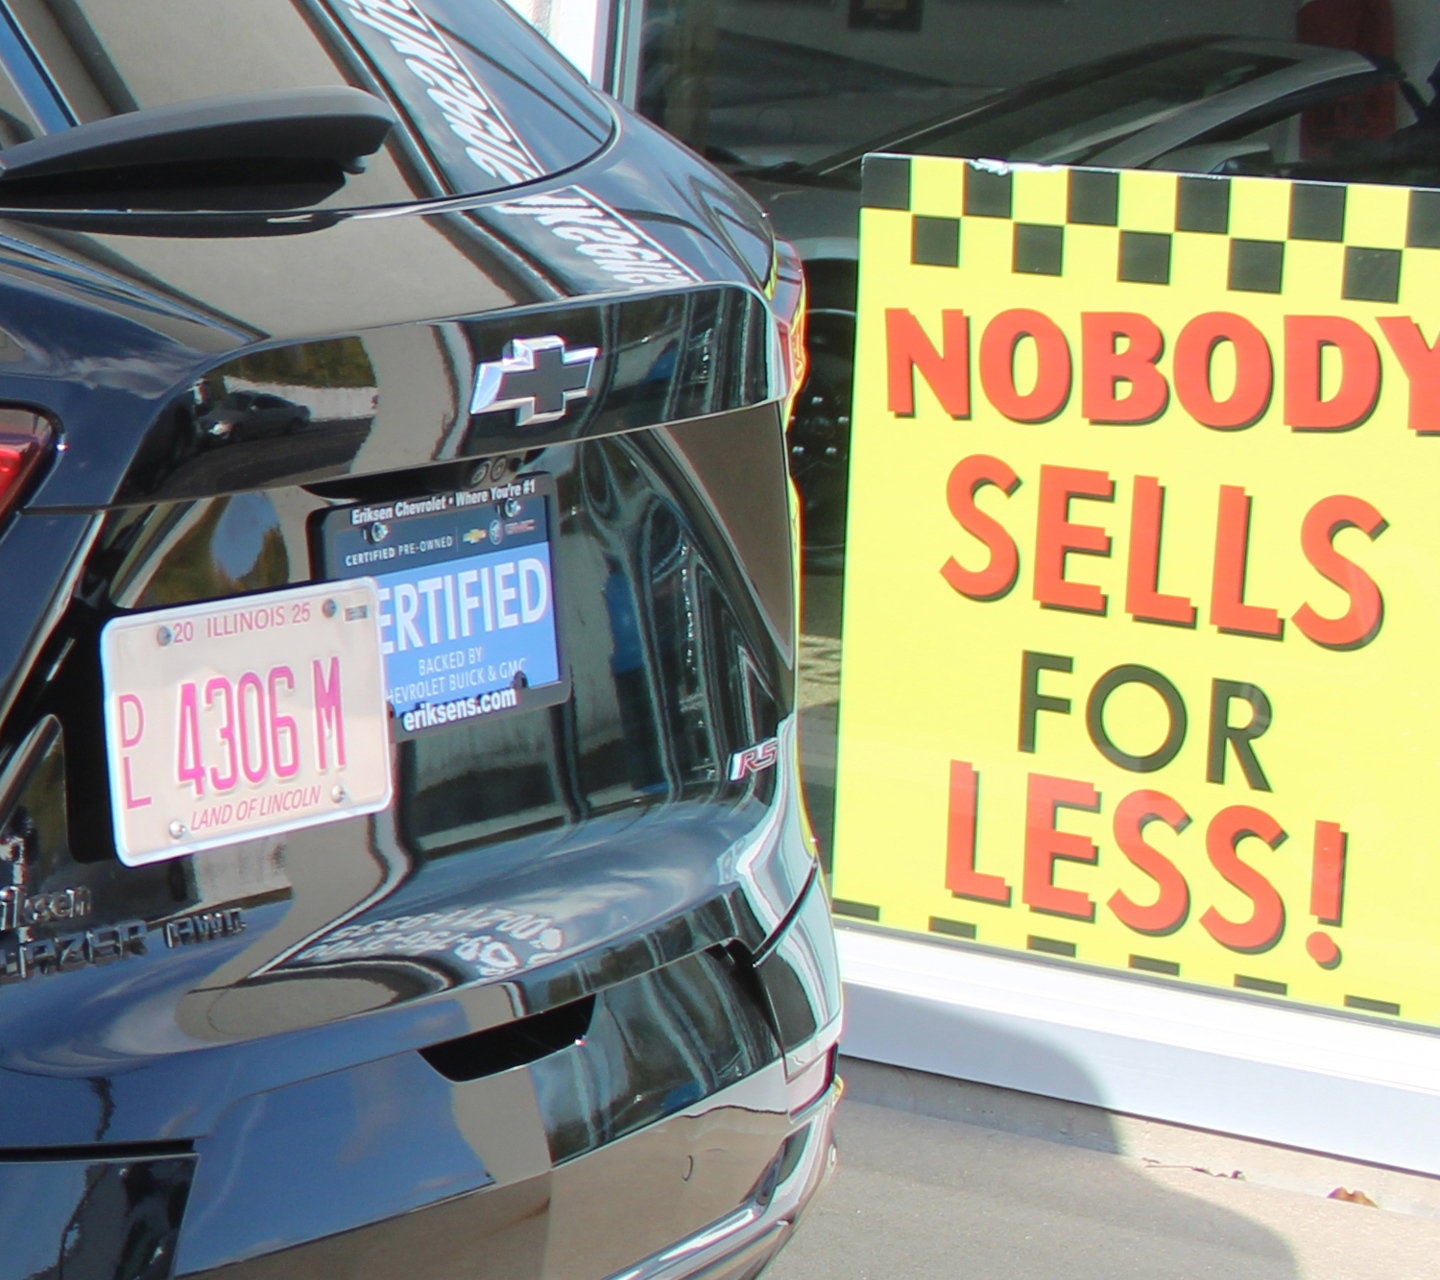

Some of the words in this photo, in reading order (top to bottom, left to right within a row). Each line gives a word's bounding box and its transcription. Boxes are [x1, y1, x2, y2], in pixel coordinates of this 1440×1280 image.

[883, 306, 1440, 435] NOBODY
[351, 503, 393, 525] Eriksen
[395, 495, 447, 519] Chevrolet
[455, 489, 488, 507] Where
[490, 482, 521, 501] You're
[522, 478, 536, 494] #1
[345, 547, 396, 567] CERTIFIED
[398, 535, 454, 556] PRE-OWNED
[938, 453, 1390, 652] SELLS
[172, 621, 194, 644] 20
[206, 605, 286, 638] ILLINOIS
[291, 603, 311, 624] 25
[378, 556, 549, 656] ERTIFIED
[418, 651, 465, 676] BACKED
[468, 646, 483, 665] BY
[384, 676, 445, 705] HEVROLET
[449, 669, 484, 692] BUICK
[487, 666, 498, 682] &
[177, 665, 300, 796] 4306
[312, 656, 347, 771] M
[403, 687, 518, 732] eriksens.com
[1016, 649, 1275, 792] FOR
[190, 803, 232, 832] LAND
[235, 798, 256, 822] OF
[259, 785, 322, 818] LINCOLN
[944, 760, 1348, 970] LESS!
